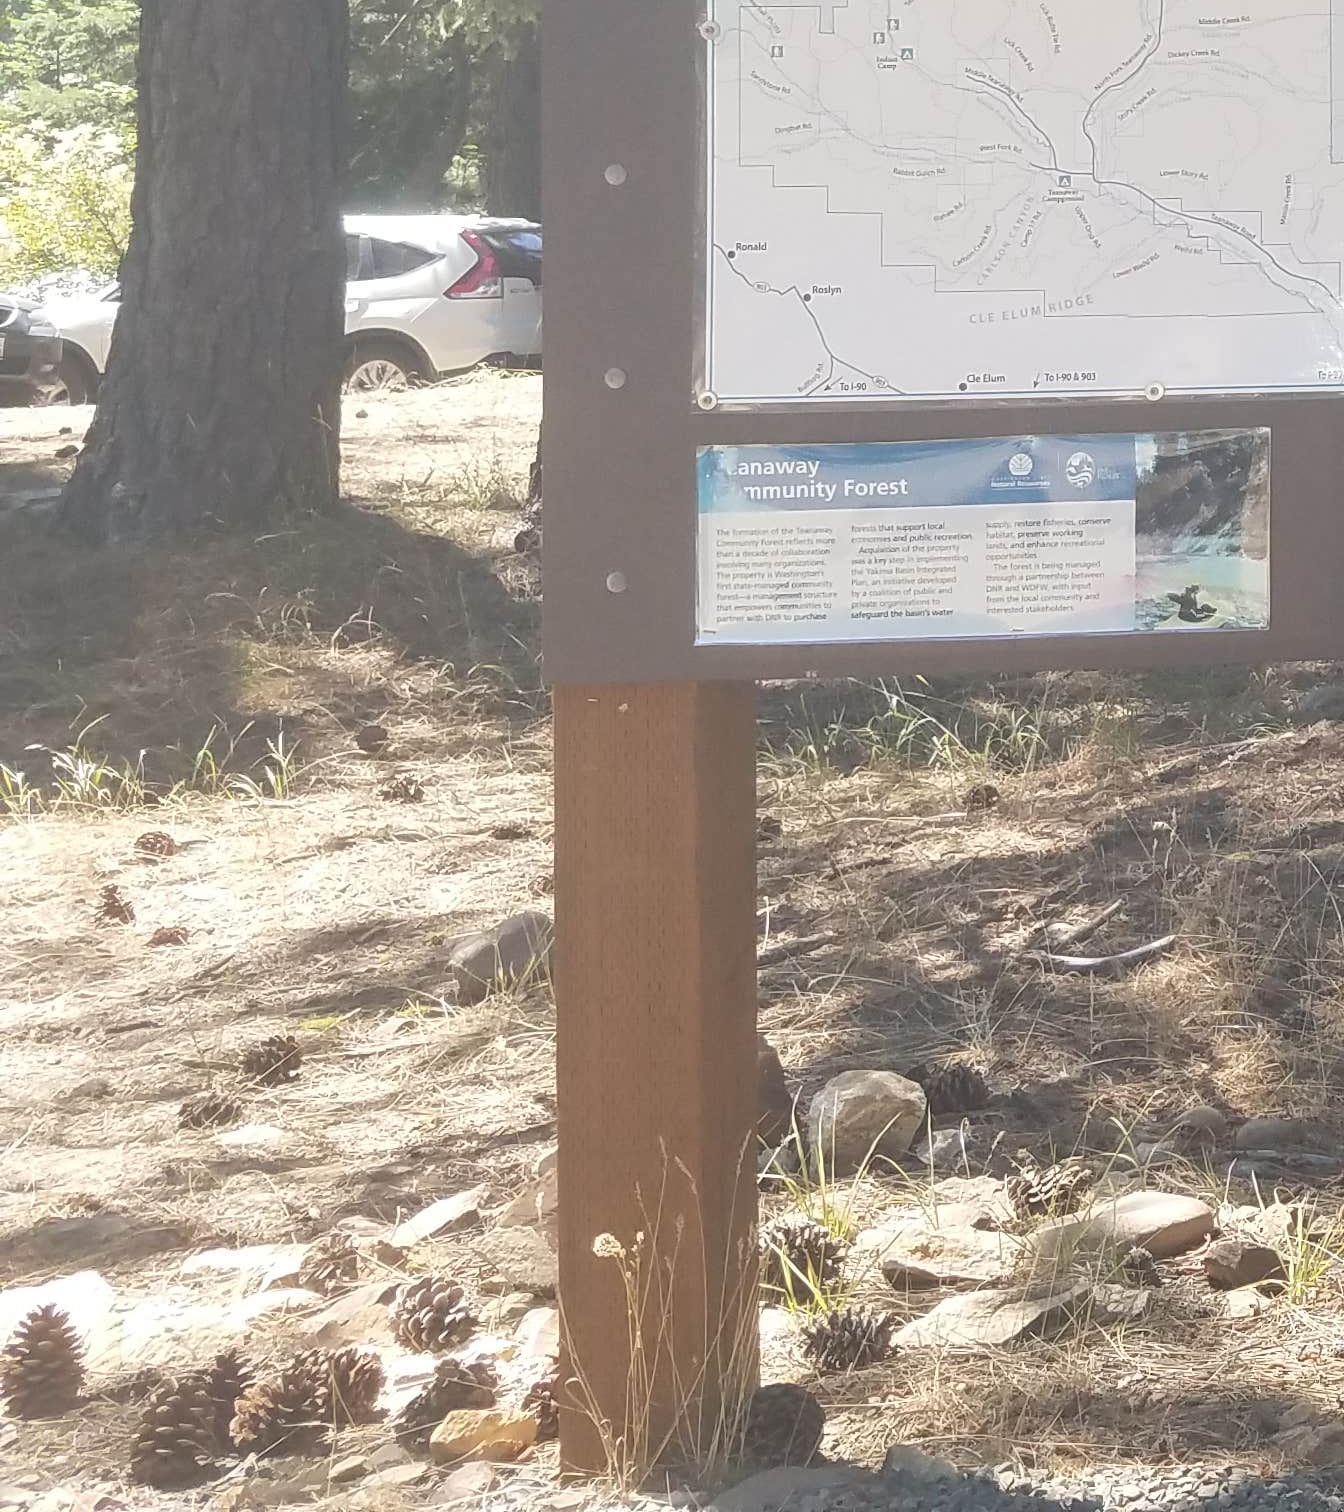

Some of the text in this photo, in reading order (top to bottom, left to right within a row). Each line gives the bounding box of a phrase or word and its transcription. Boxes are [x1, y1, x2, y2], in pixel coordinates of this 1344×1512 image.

[736, 242, 766, 251] Ronald
[812, 286, 841, 296] Roslyn
[969, 294, 1094, 323] CLE ELUM RIDGE
[967, 374, 1005, 382] Cle Elum
[1045, 373, 1054, 381] To
[727, 460, 820, 477] anaway
[744, 479, 908, 502] mmunity Forest
